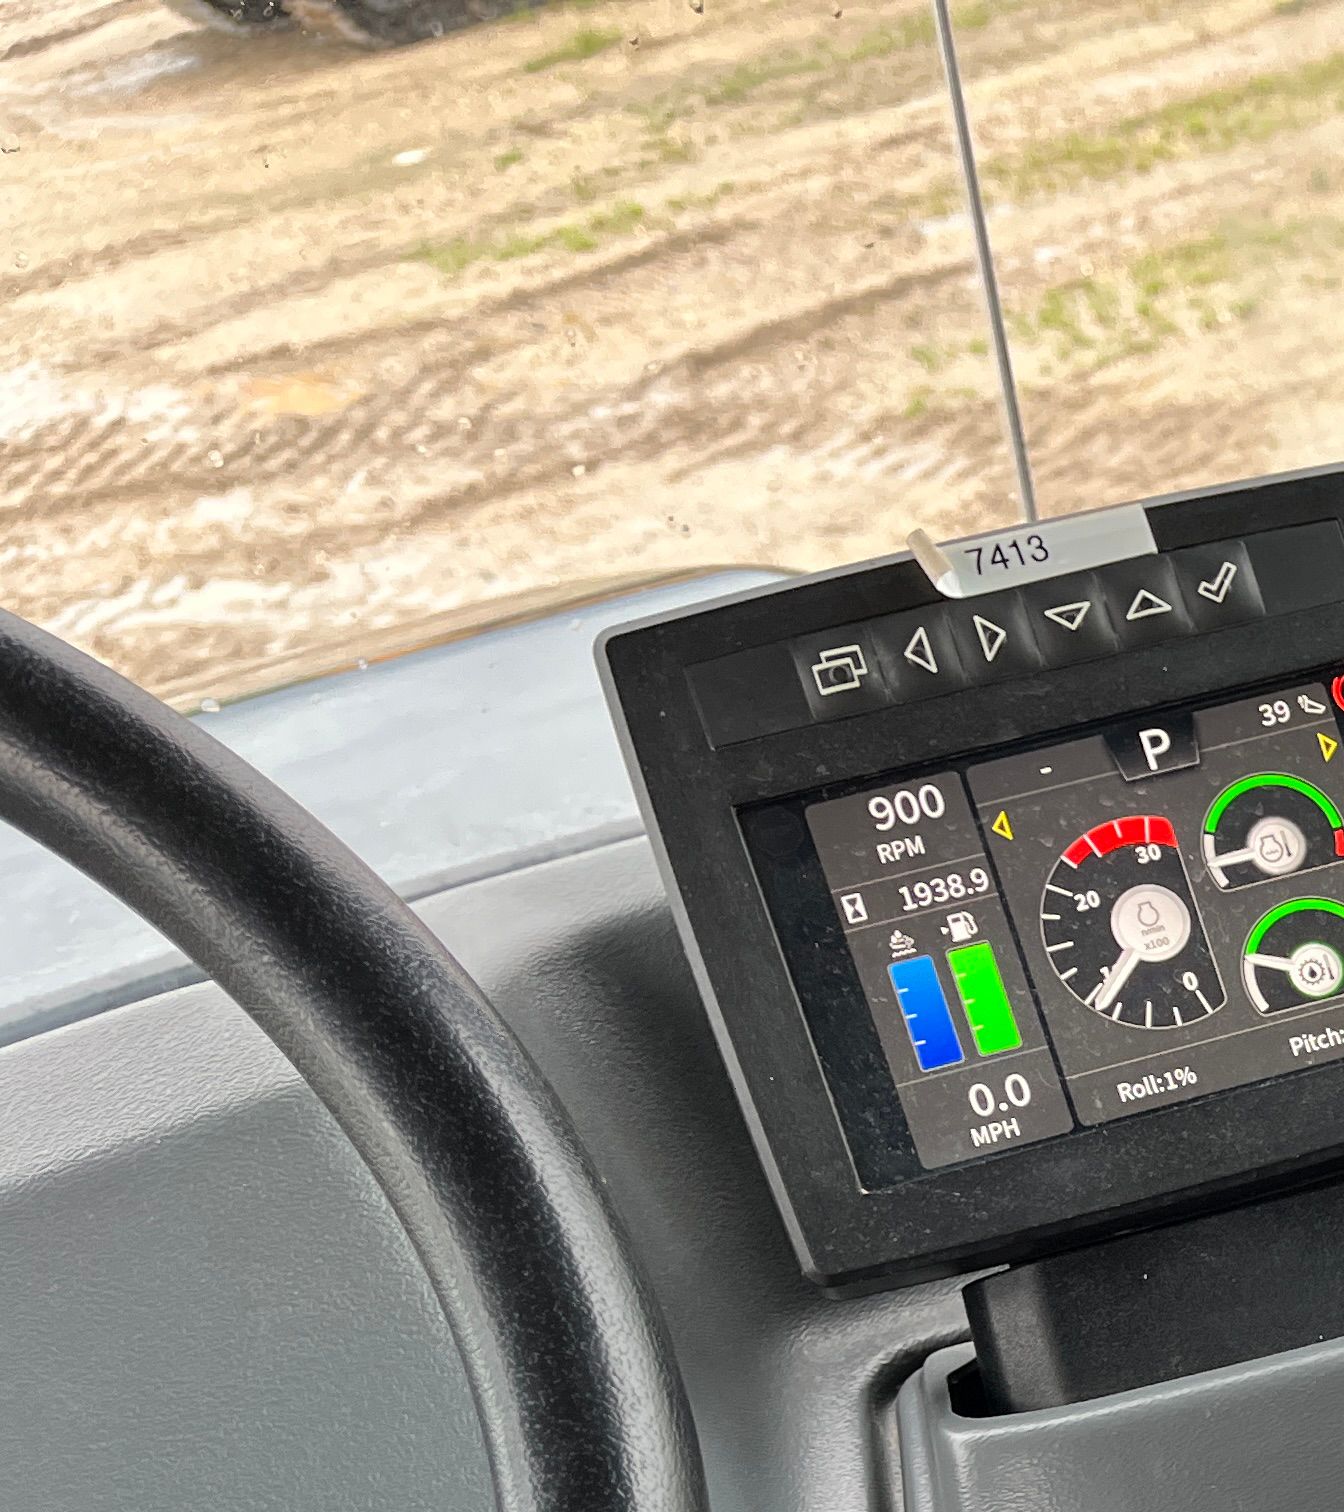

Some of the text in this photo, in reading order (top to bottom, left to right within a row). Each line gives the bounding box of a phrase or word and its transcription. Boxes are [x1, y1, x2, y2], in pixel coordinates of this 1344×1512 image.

[963, 534, 1050, 576] 7413
[1257, 700, 1292, 727] 39
[1138, 728, 1171, 771] P
[867, 783, 946, 832] 900
[876, 835, 926, 864] RPM
[1134, 844, 1162, 864] 30
[898, 867, 990, 911] 1938.9
[1073, 890, 1101, 912] 20
[1182, 971, 1199, 991] 0
[967, 1073, 1032, 1117] 0.0
[1116, 1066, 1198, 1103] Roll:1%
[969, 1118, 1022, 1148] MPH
